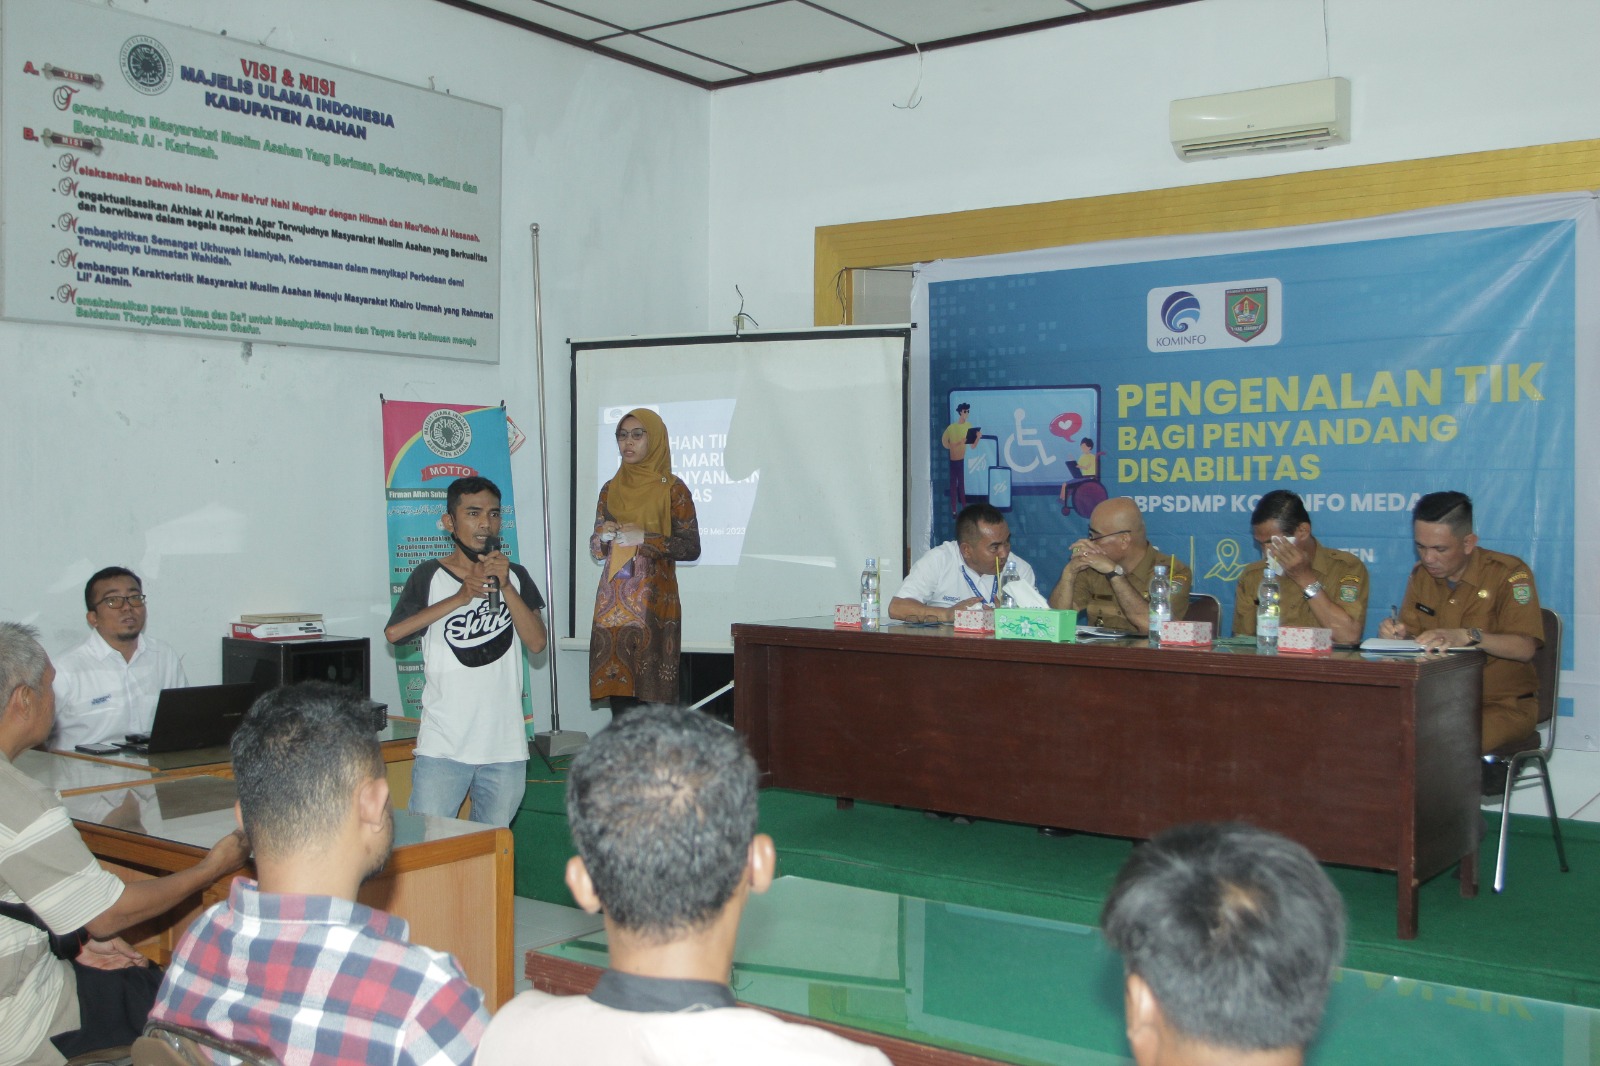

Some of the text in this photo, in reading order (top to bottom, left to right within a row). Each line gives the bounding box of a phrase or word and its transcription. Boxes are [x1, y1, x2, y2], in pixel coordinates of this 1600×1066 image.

[23, 60, 40, 76] A.
[64, 71, 84, 81] VISI
[240, 58, 336, 98] VISI & MISI
[180, 65, 394, 128] MAJELIS ULAMA INDONESIA
[205, 91, 366, 140] KABUPATEN ASAHAN
[23, 127, 39, 142] B.
[62, 137, 83, 147] MISI
[73, 120, 139, 146] Berakhlak
[142, 134, 154, 147] Al
[165, 138, 218, 160] Karimah.
[149, 116, 218, 142] Masyarakat
[221, 130, 260, 150] Muslim
[263, 139, 303, 158] Asahan
[306, 147, 330, 166] Yang
[334, 154, 376, 175] Beriman,
[379, 163, 426, 186] Bertaqwa,
[428, 173, 460, 190] Berilmu
[463, 182, 478, 194] dan
[78, 201, 293, 242] dan berwibawa dalam segala aspek kehidupan.
[145, 176, 182, 192] Dakwah
[186, 183, 212, 198] Islam,
[216, 188, 239, 201] Amar
[242, 192, 268, 206] Ma'ruf
[271, 198, 290, 210] Nahi
[292, 202, 327, 216] Mungkar
[329, 208, 357, 222] dengan
[359, 214, 388, 226] Hikmah
[390, 219, 402, 228] dan
[442, 228, 448, 236] Al
[450, 230, 480, 242] Hasanah.
[77, 236, 232, 266] Terwujudnya Ummatan Wahidah.
[170, 205, 202, 218] Akhlak
[205, 209, 214, 219] Al
[217, 211, 253, 226] Karimah
[256, 218, 276, 230] Agar
[278, 220, 330, 238] Terwujudnya
[331, 229, 376, 244] Masyarakat
[378, 236, 404, 248] Muslim
[405, 241, 432, 254] Asahan
[433, 248, 449, 258] yang
[451, 249, 488, 262] Berkualitas
[151, 235, 198, 250] Semangat
[200, 242, 241, 256] Ukhuwah
[244, 248, 286, 264] Islamiyah,
[289, 254, 343, 270] Kebersamaan
[346, 262, 368, 274] dalam
[370, 268, 408, 280] menyikapi
[410, 272, 446, 285] Perbedaan
[448, 278, 464, 288] demi
[94, 273, 132, 288] Alamin.
[132, 266, 194, 284] Karakteristik
[197, 274, 248, 290] Masyarakat
[250, 281, 280, 294] Muslim
[282, 286, 312, 298] Asahan
[314, 289, 342, 302] Menuju
[344, 292, 388, 307] Masyarakat
[390, 298, 414, 310] Khairo
[416, 302, 442, 314] Ummah
[444, 308, 460, 316] yang
[462, 308, 494, 320] Rahmatan
[1156, 334, 1206, 346] KOMINFO
[1118, 362, 1544, 418] PENGENALAN TIK
[670, 436, 704, 450] HAN
[1118, 415, 1458, 450] BAGI PENYANDANG
[430, 466, 470, 476] MOTTO
[1118, 454, 1320, 483] DISABILITAS
[1120, 495, 1226, 512] BPSDMP
[1351, 493, 1422, 512] MEDA
